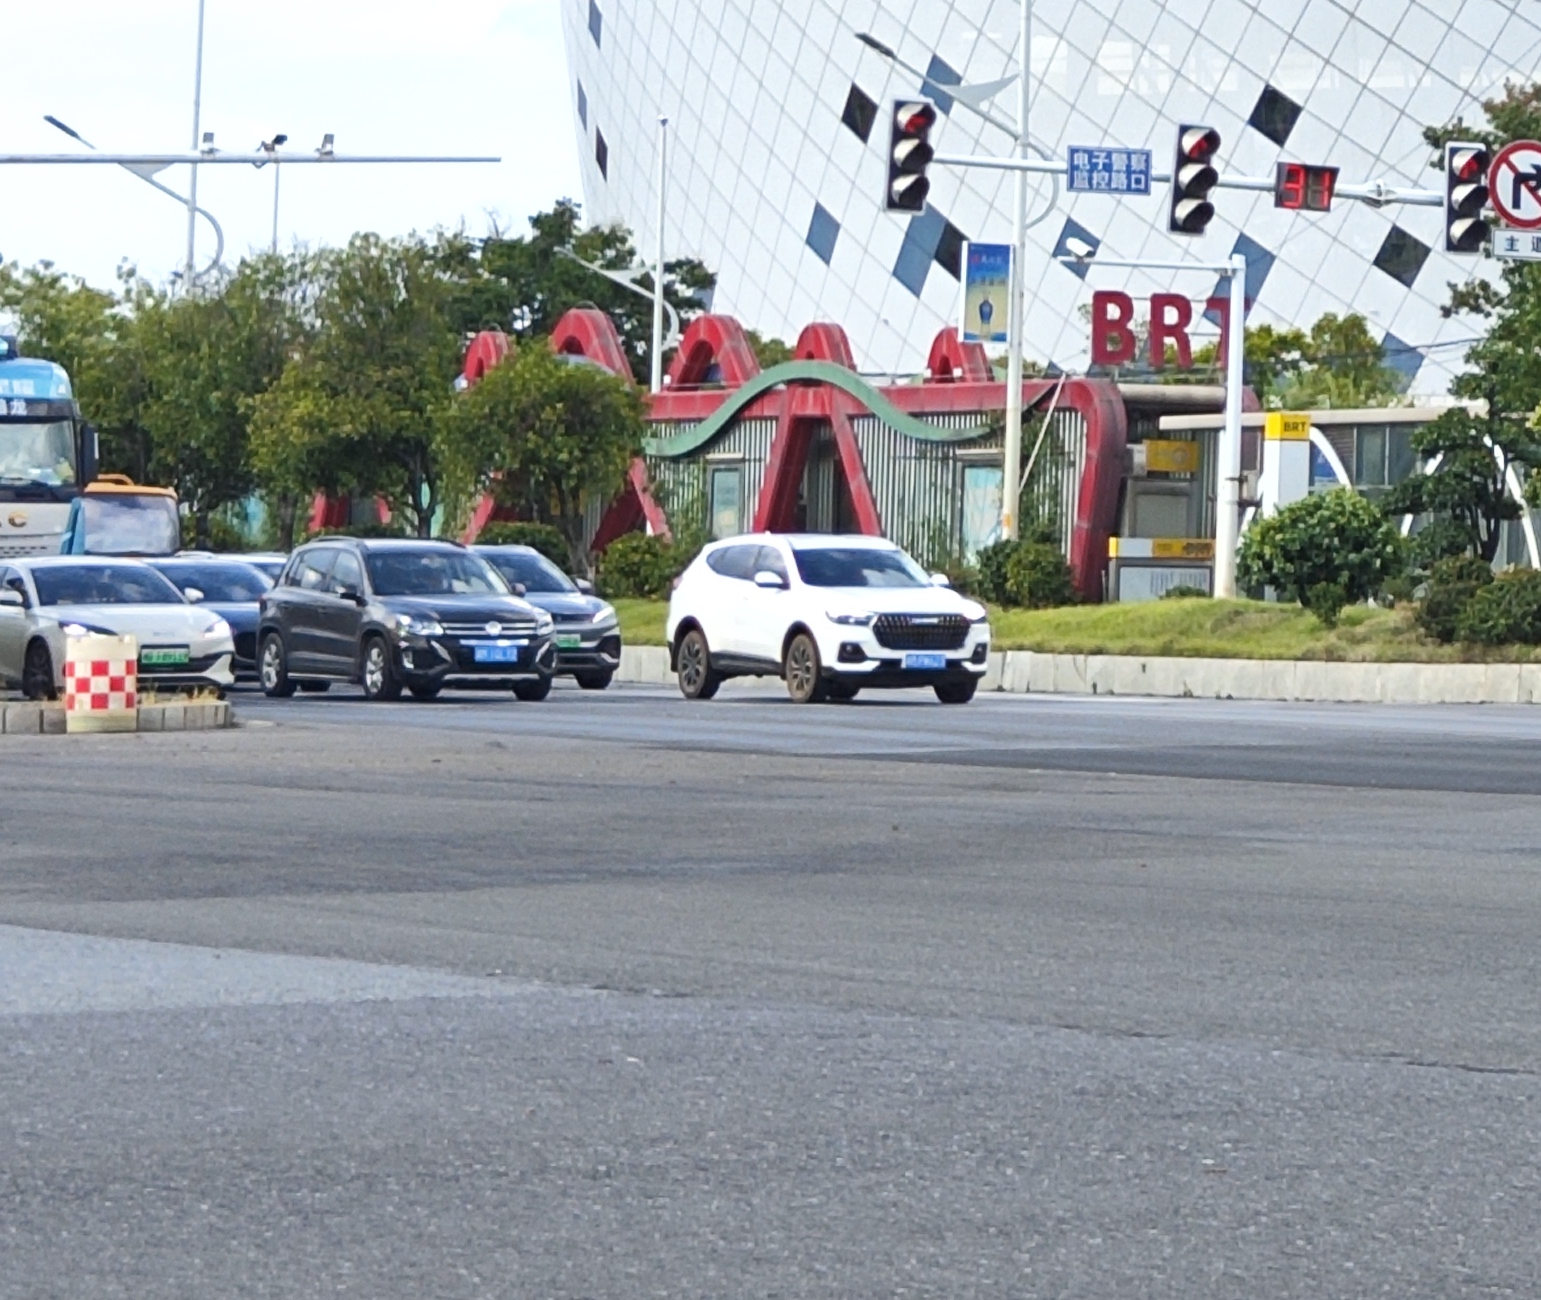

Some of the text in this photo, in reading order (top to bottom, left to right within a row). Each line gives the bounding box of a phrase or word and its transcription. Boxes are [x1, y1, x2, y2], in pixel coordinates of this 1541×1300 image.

[1074, 150, 1147, 172] 电子警察
[1073, 169, 1146, 190] 监控路口
[1283, 163, 1331, 209] 31
[1284, 421, 1306, 432] BRT
